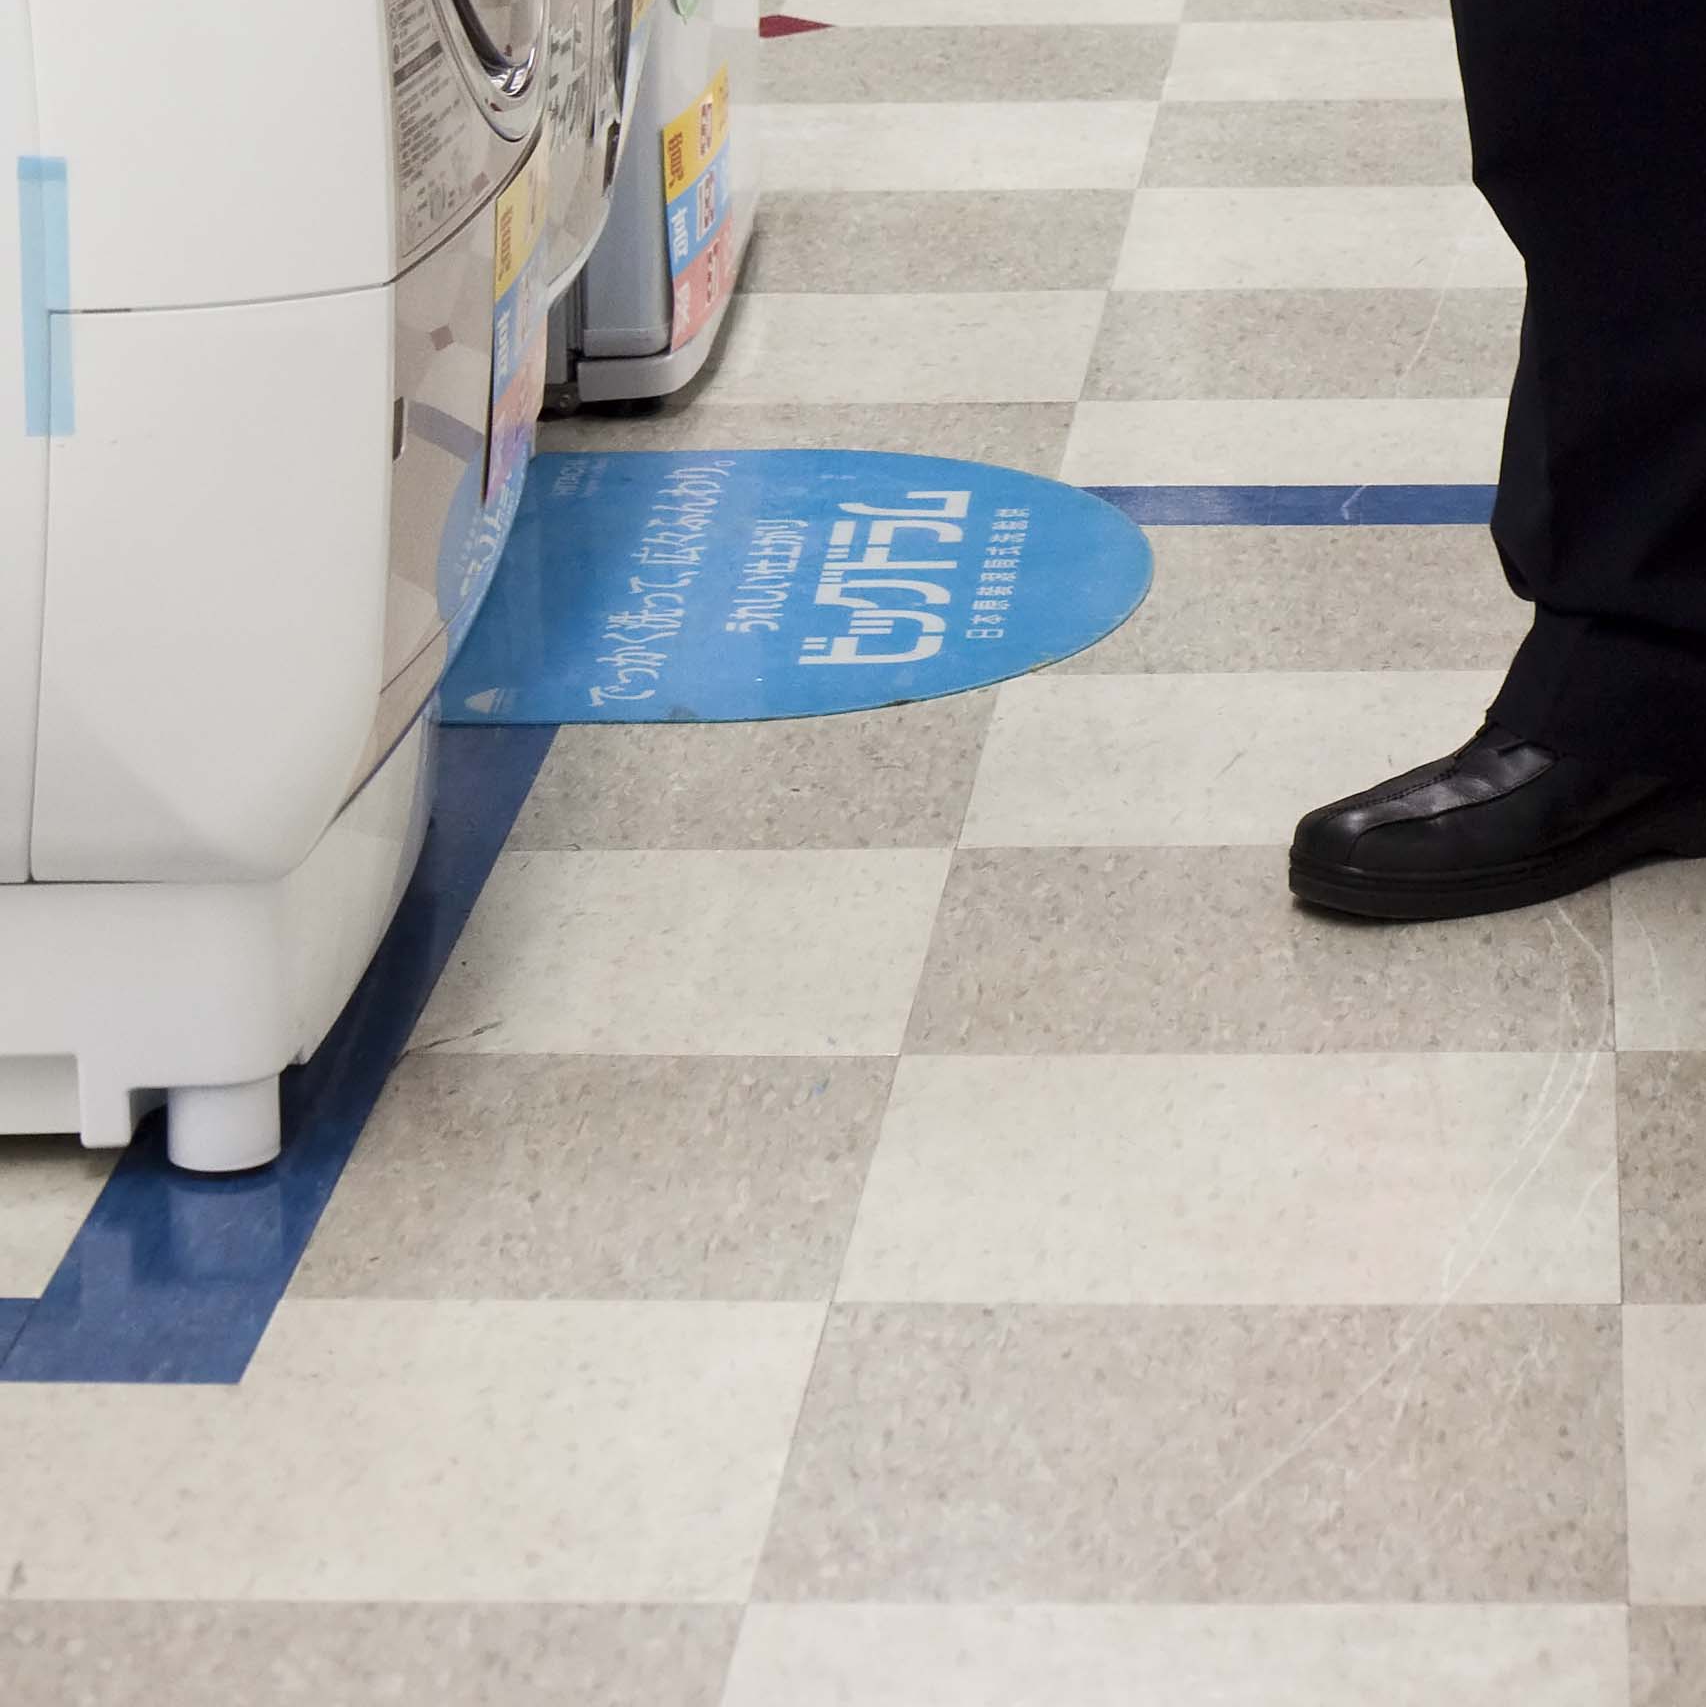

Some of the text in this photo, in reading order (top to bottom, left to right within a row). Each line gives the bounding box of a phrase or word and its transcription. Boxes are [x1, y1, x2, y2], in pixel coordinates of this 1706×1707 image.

[725, 517, 809, 633] うれしい仕上がり
[799, 490, 972, 666] ビッグドラム
